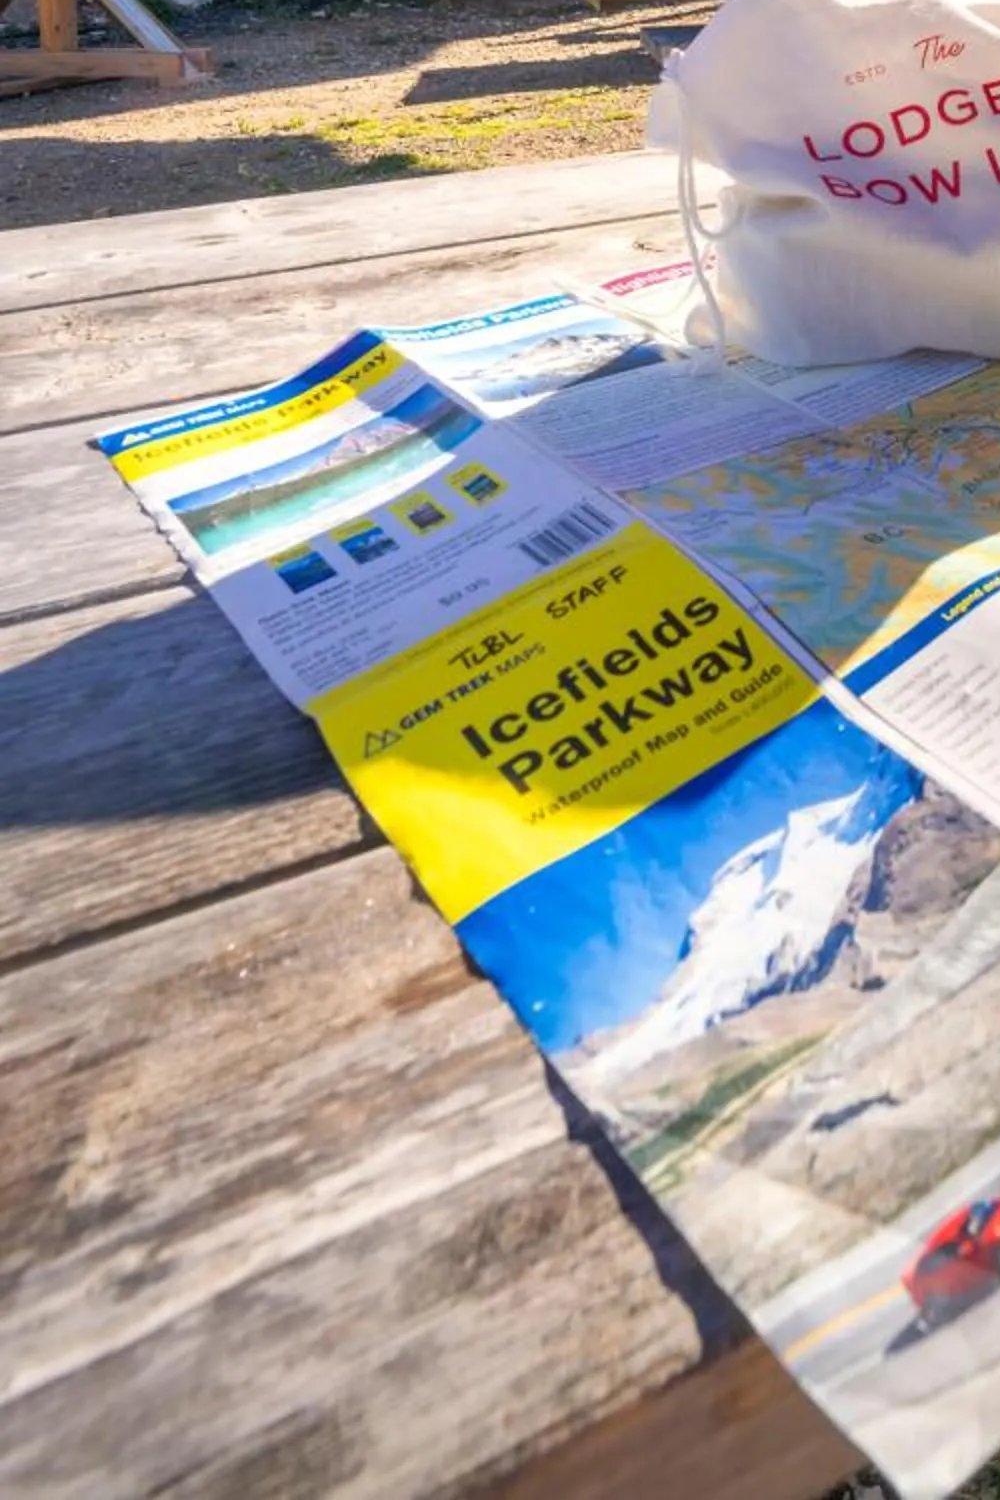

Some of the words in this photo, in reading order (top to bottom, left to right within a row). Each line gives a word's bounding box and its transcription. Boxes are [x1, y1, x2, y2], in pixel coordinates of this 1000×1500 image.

[913, 33, 966, 69] The
[820, 160, 961, 206] BOW
[277, 349, 388, 418] Parkway
[546, 565, 627, 619] STAFF
[399, 699, 444, 731] GEM
[446, 671, 494, 703] TREK
[496, 642, 546, 675] MAPS
[461, 596, 720, 759] Icefields
[499, 626, 753, 796] Parkway
[524, 750, 643, 825] Waterproof
[645, 721, 690, 755] Map
[693, 699, 729, 728] and
[729, 663, 783, 704] Guide
